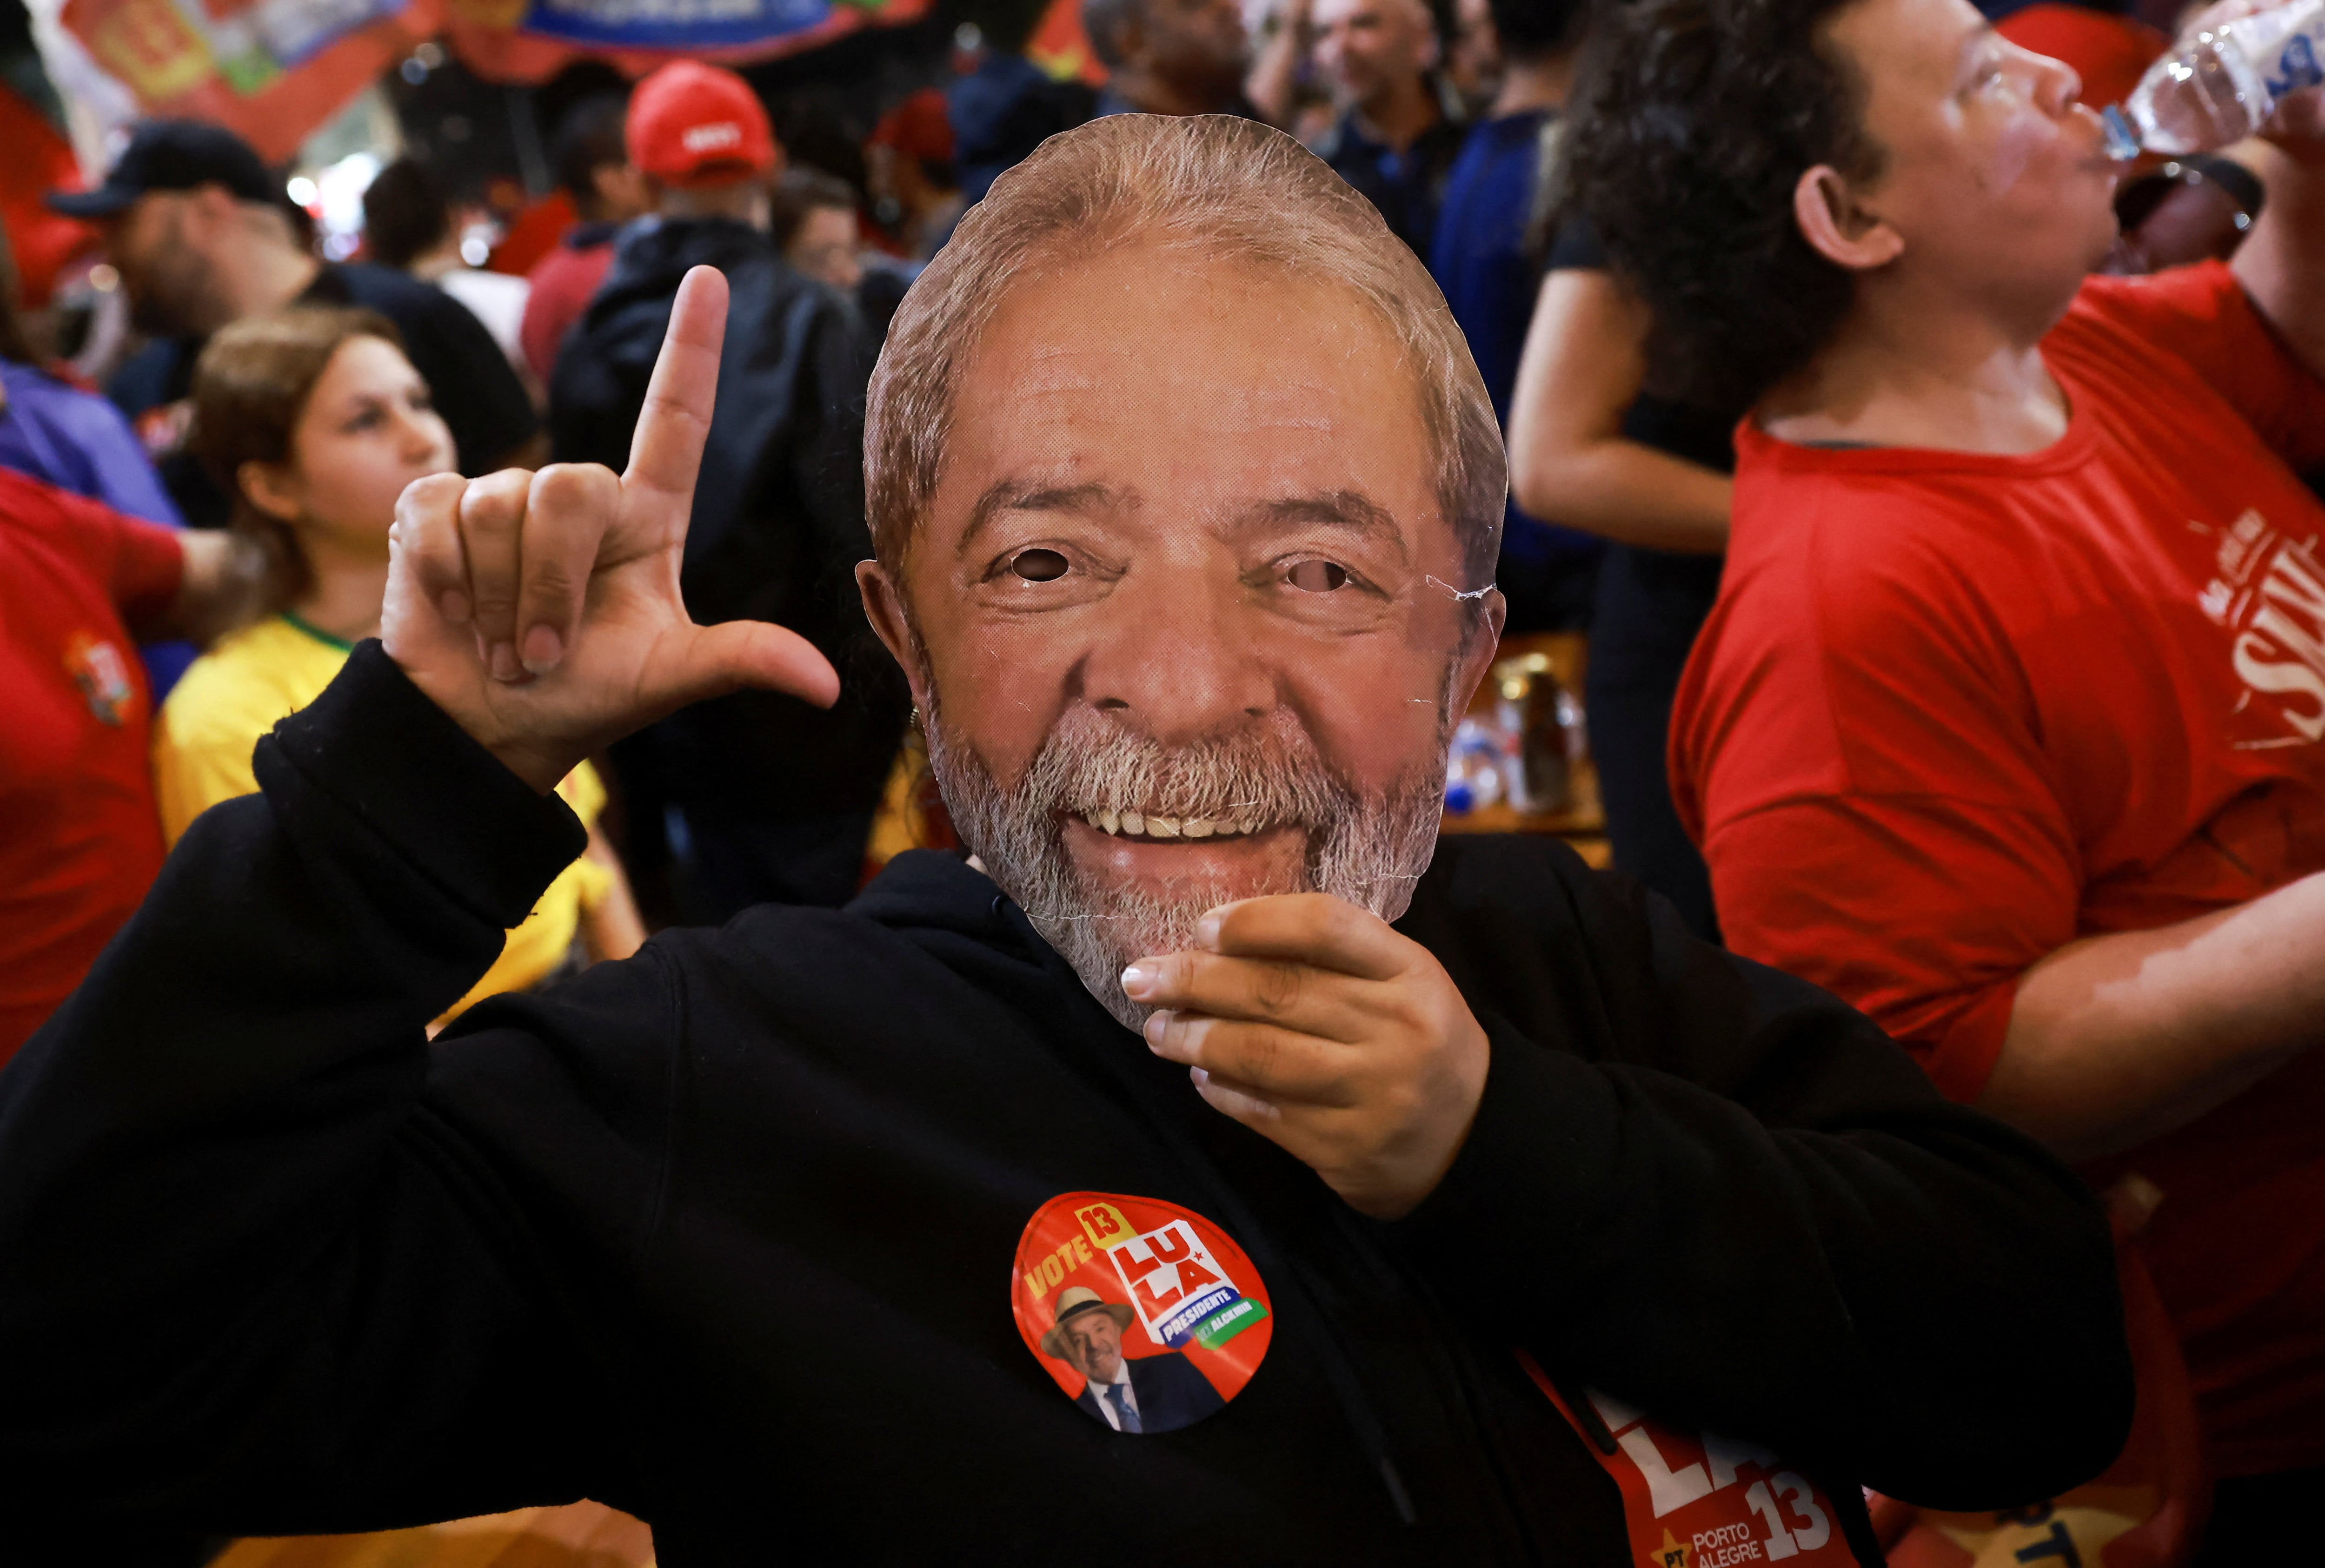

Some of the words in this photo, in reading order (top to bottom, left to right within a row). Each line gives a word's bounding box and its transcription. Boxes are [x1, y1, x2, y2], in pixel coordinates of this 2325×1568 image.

[1023, 1234, 1094, 1301] VOTE
[1081, 1206, 1120, 1240] 13
[1163, 1289, 1232, 1342] PRESIDENTE
[1746, 1471, 1830, 1561] 13
[1664, 1549, 1684, 1568] PT
[1693, 1522, 1750, 1553] PORTO
[1698, 1540, 1762, 1568] ALEGRE
